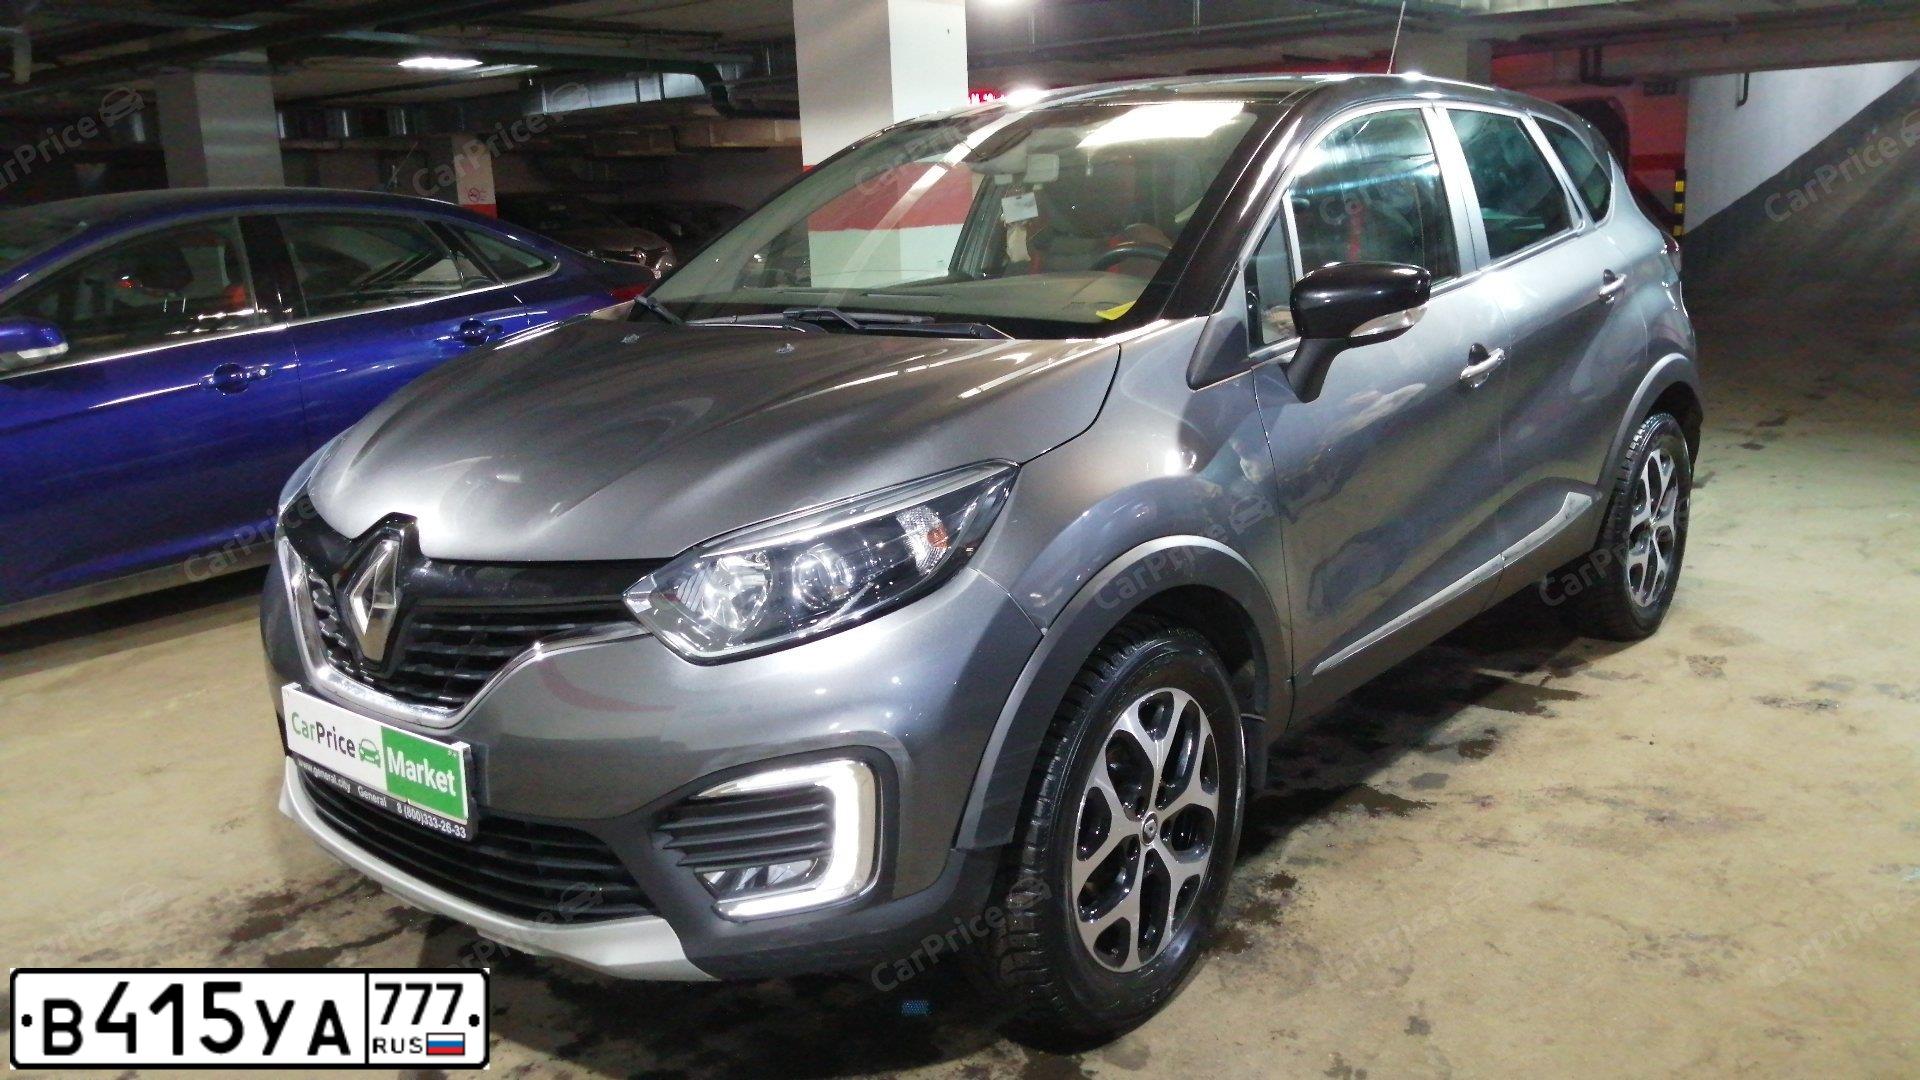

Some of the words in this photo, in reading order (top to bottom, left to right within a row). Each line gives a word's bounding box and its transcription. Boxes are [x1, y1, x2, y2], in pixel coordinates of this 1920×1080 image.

[290, 711, 357, 759] CarPrice
[386, 746, 457, 797] Market
[358, 785, 388, 807] General
[396, 803, 402, 814] 8
[403, 806, 467, 839] (800)333-26-33
